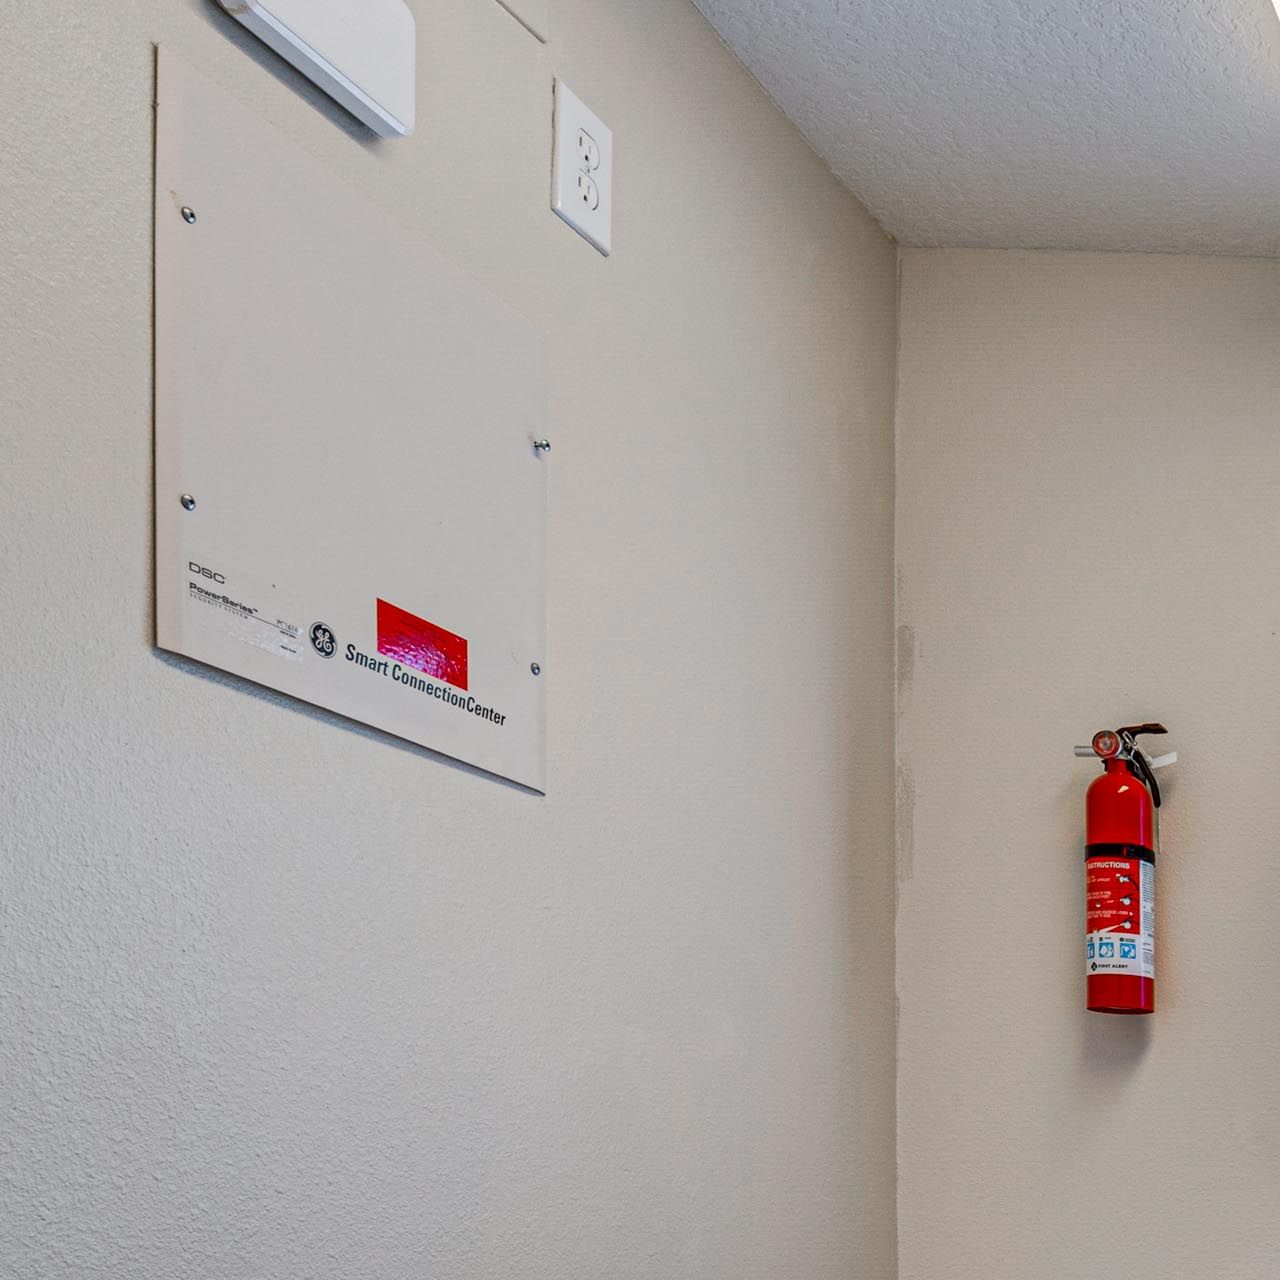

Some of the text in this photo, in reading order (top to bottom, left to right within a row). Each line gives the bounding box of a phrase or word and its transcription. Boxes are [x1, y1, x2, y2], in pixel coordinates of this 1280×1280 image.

[188, 561, 225, 584] DSC
[345, 643, 506, 726] Smart ConnectionCenter
